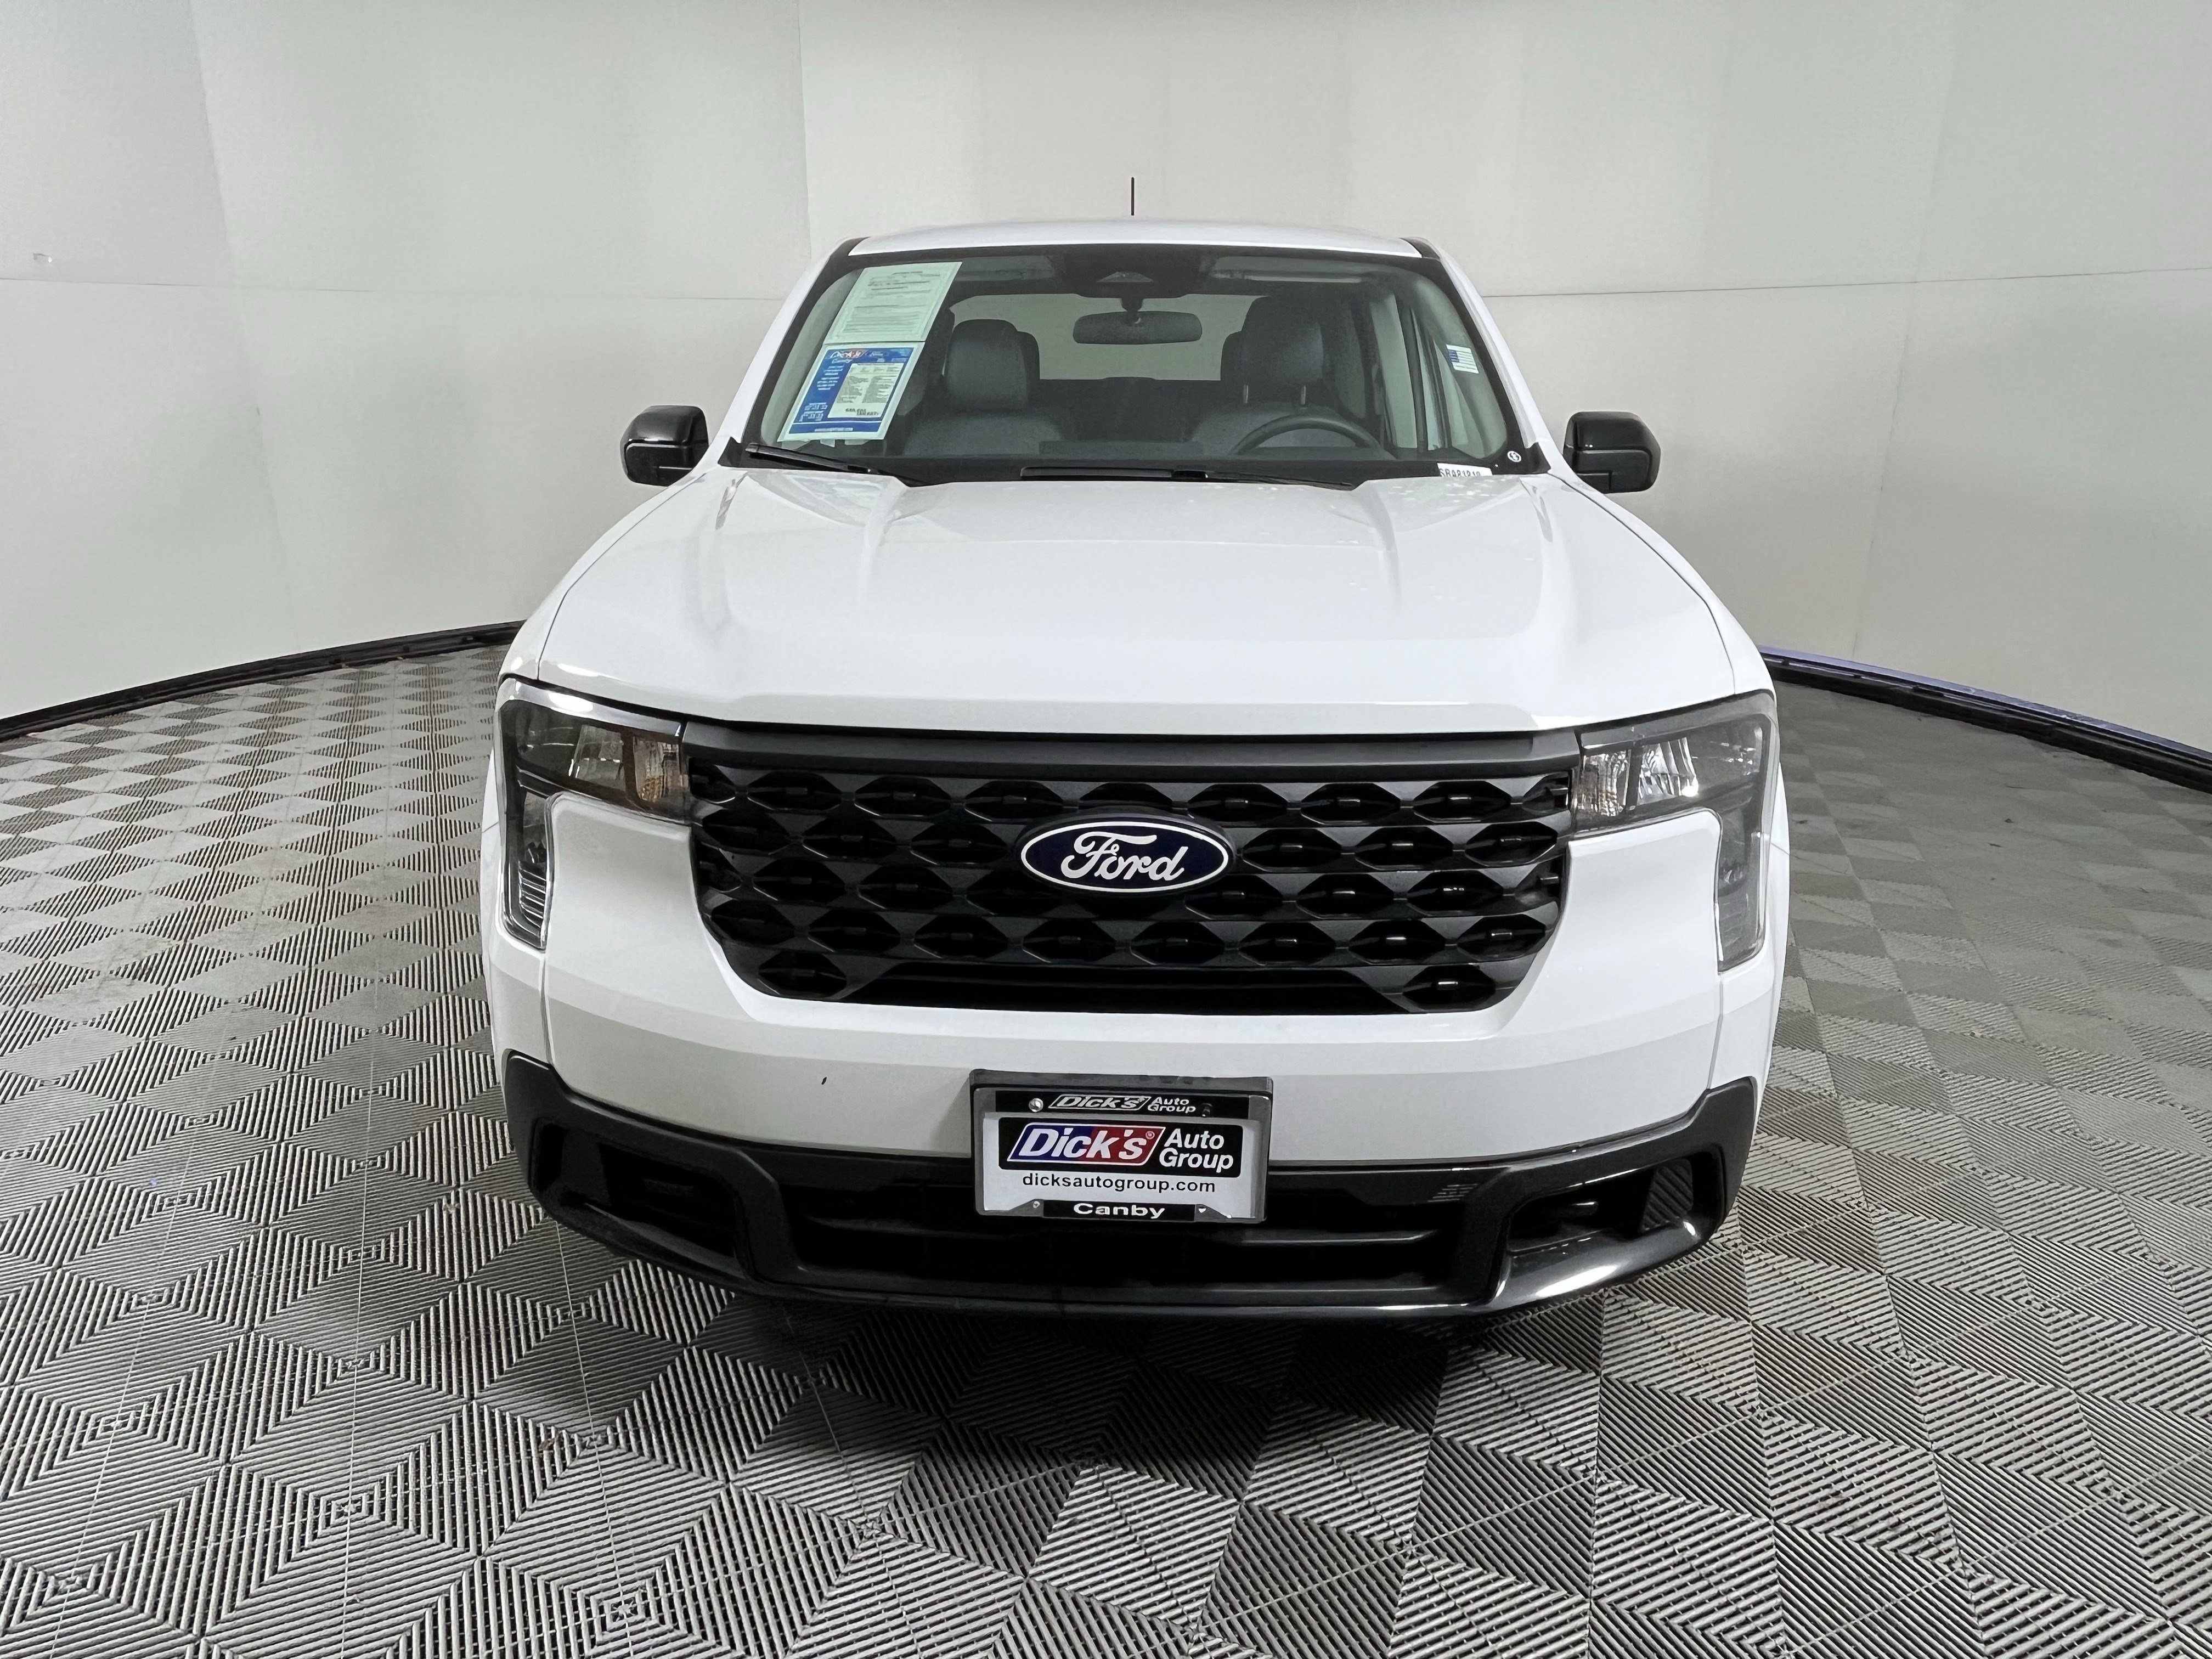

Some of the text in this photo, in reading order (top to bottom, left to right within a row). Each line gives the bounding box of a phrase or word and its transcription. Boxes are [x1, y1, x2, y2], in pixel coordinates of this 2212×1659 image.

[1060, 831, 1189, 881] Ford
[1056, 1096, 1189, 1109] Dick's Auto
[1147, 1103, 1197, 1114] Group
[1018, 1126, 1224, 1161] Dick's Auto
[1159, 1149, 1234, 1173] Group
[1022, 1172, 1216, 1193] dicksautogroup.com
[1073, 1202, 1165, 1219] Canby
